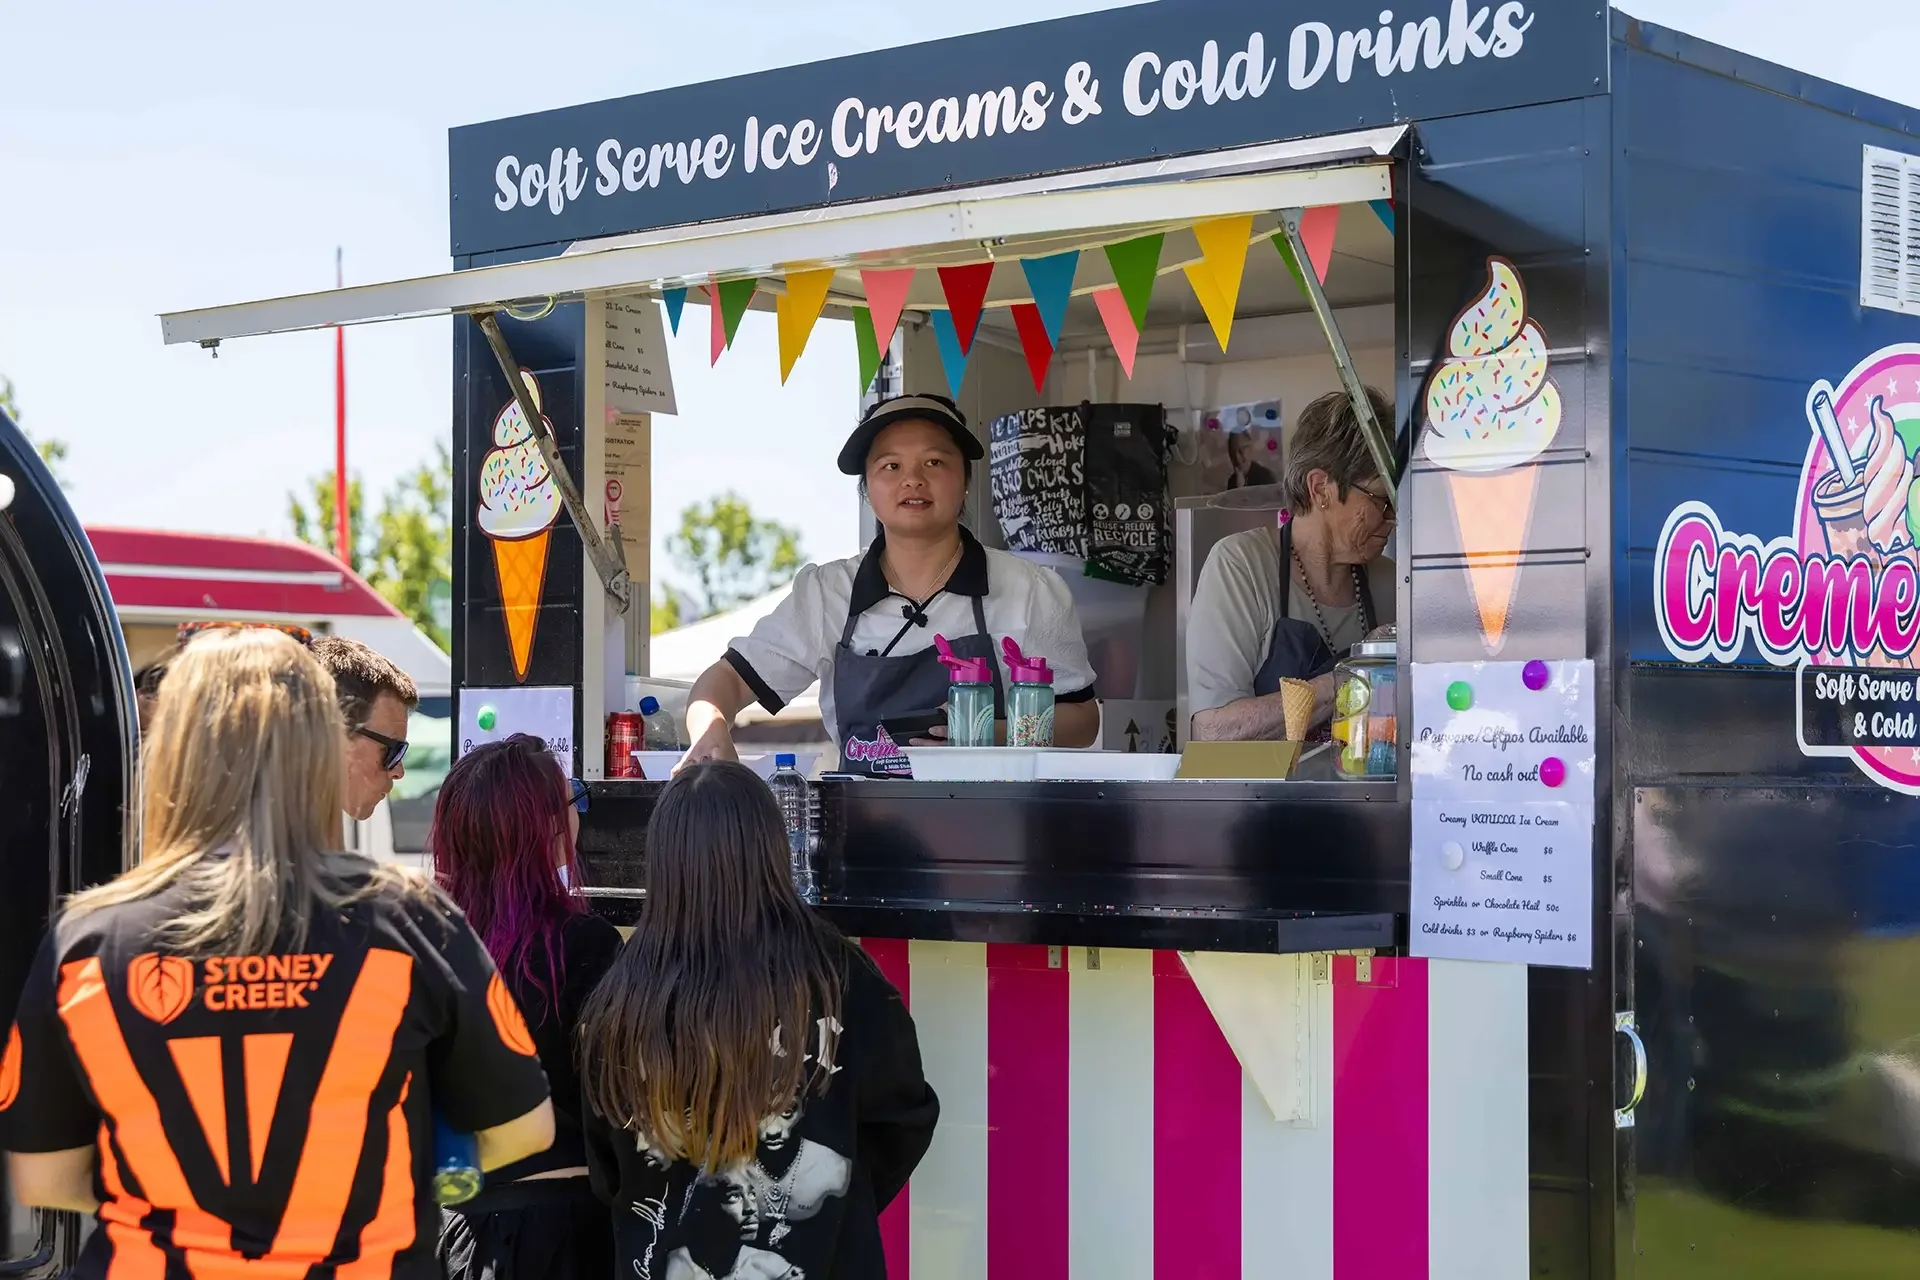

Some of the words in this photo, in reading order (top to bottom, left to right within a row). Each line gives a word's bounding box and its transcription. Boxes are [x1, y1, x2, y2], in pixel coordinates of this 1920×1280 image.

[495, 146, 588, 215] Soft
[595, 133, 735, 196] Serve
[744, 115, 822, 175] Ice
[830, 80, 1053, 158] Creams
[1061, 61, 1101, 125] &
[1123, 32, 1275, 117] Cold
[1288, 0, 1534, 90] Drinks
[1050, 412, 1083, 434] KIA
[1034, 452, 1066, 468] cloud
[1027, 466, 1069, 490] CHUR
[1093, 521, 1118, 530] REUSE
[1124, 522, 1156, 531] RELOVE
[1094, 528, 1157, 547] RECYCLE
[1815, 672, 1857, 705] Soft
[1858, 673, 1913, 702] Serve
[1529, 725, 1588, 744] Available
[1853, 711, 1868, 738] &
[1871, 711, 1917, 739] Cold
[1462, 764, 1482, 782] No
[1486, 763, 1513, 781] cash
[1517, 765, 1539, 781] out
[1439, 813, 1467, 828] Creamy
[1471, 813, 1516, 825] VANILLA
[1519, 815, 1531, 826] Ice
[1535, 816, 1559, 826] Cream
[1472, 842, 1498, 855] Waffle
[1500, 843, 1518, 853] Cone
[1544, 846, 1553, 855] $6
[1480, 870, 1503, 881] Small
[1504, 871, 1523, 882] Cone
[1543, 875, 1552, 883] $5
[1433, 896, 1468, 911] Sprinkles
[1484, 898, 1520, 910] Chocolate
[1521, 899, 1540, 911] Hail
[1546, 904, 1559, 912] 50c
[1422, 923, 1440, 934] Cold
[1440, 924, 1463, 935] drinks
[1466, 928, 1476, 936] $3
[1493, 927, 1532, 943] Raspberry
[1534, 930, 1563, 944] Spiders
[1567, 933, 1577, 942] $6
[204, 953, 334, 986] STONEY
